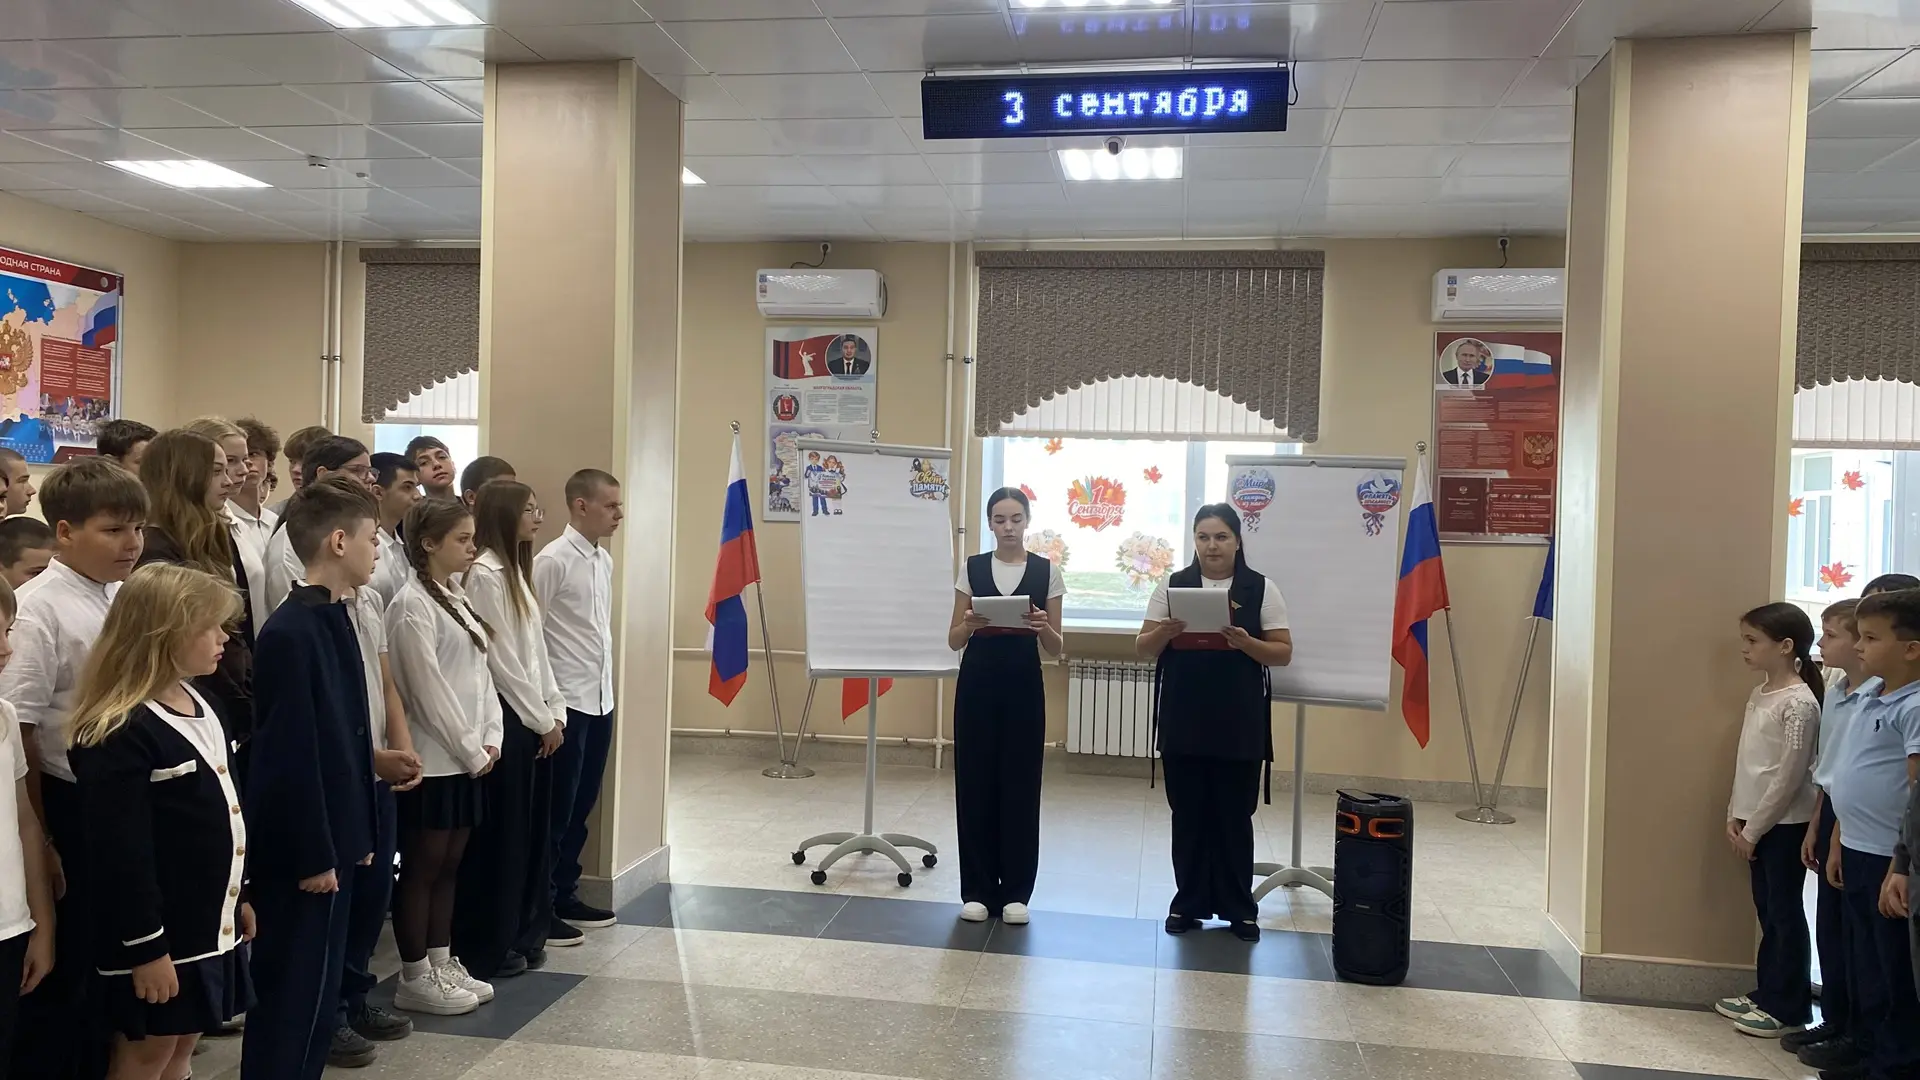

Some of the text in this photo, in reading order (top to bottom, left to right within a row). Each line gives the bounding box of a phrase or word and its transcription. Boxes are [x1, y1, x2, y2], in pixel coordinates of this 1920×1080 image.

[1003, 87, 1248, 124] 3 сентября
[30, 263, 61, 277] СТРАНА
[915, 471, 944, 485] Свет
[1245, 478, 1265, 488] Мир
[1091, 485, 1104, 504] 1
[1068, 500, 1125, 519] Сентября
